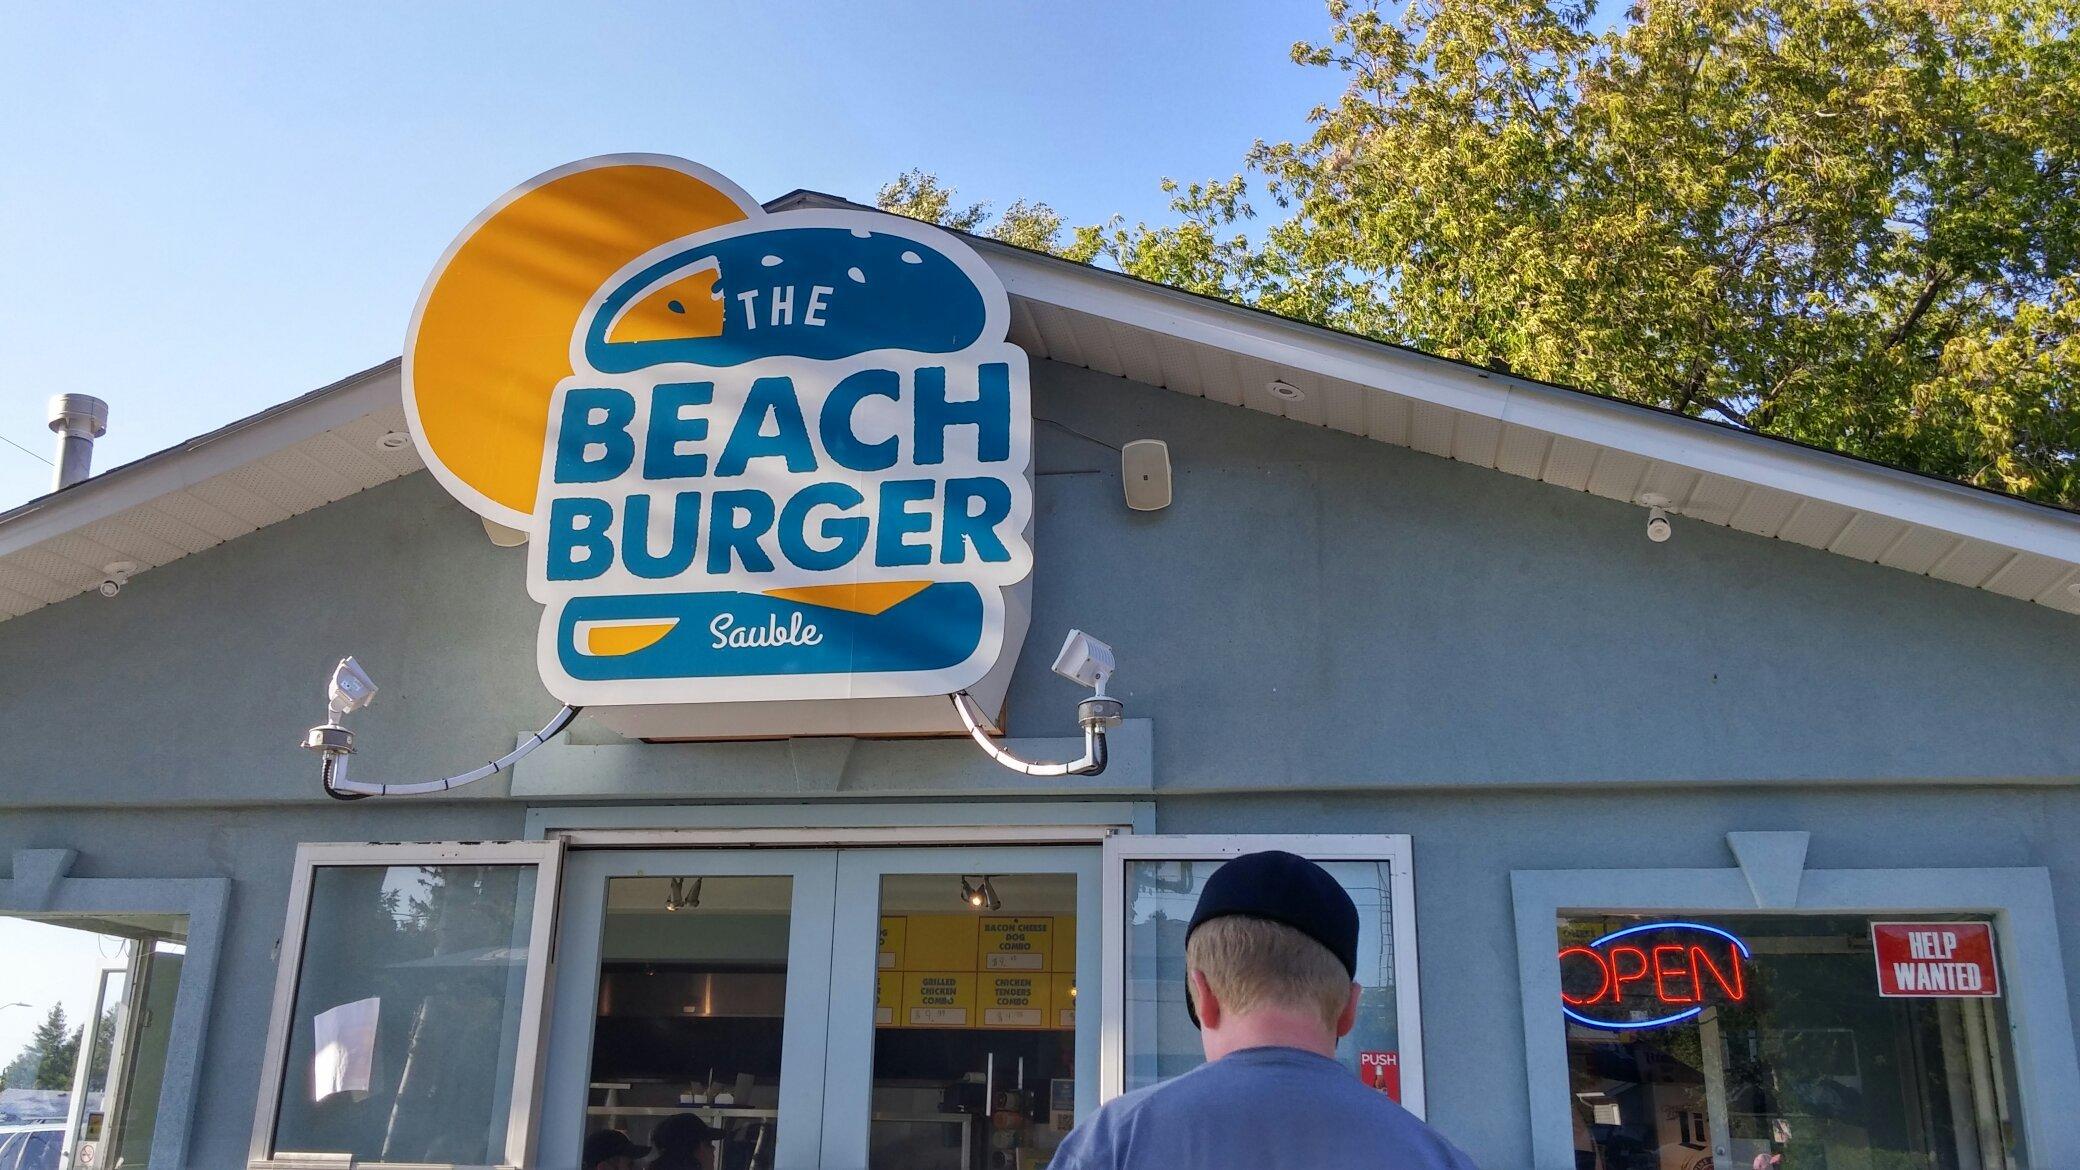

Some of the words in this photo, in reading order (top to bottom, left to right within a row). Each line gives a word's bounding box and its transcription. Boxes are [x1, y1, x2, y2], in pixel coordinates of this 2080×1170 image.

[737, 285, 835, 330] THE
[554, 362, 1010, 484] BEACH
[546, 476, 1012, 582] BURGER
[709, 611, 824, 649] Sauble
[984, 924, 1015, 932] BACON
[1017, 924, 1048, 932] CHEESE
[1005, 933, 1025, 941] DOG
[1908, 931, 1957, 960] HELP
[1560, 943, 1744, 1004] OPEN
[1893, 962, 1982, 991] WANTED
[922, 978, 957, 986] GRILLED
[995, 979, 1032, 987] CHICKEN
[920, 987, 957, 995] CHICKEN
[995, 988, 1032, 997] TENDERS
[922, 997, 955, 1005] COMBO
[996, 998, 1029, 1006] COMBO
[1361, 1053, 1397, 1066] PUSH
